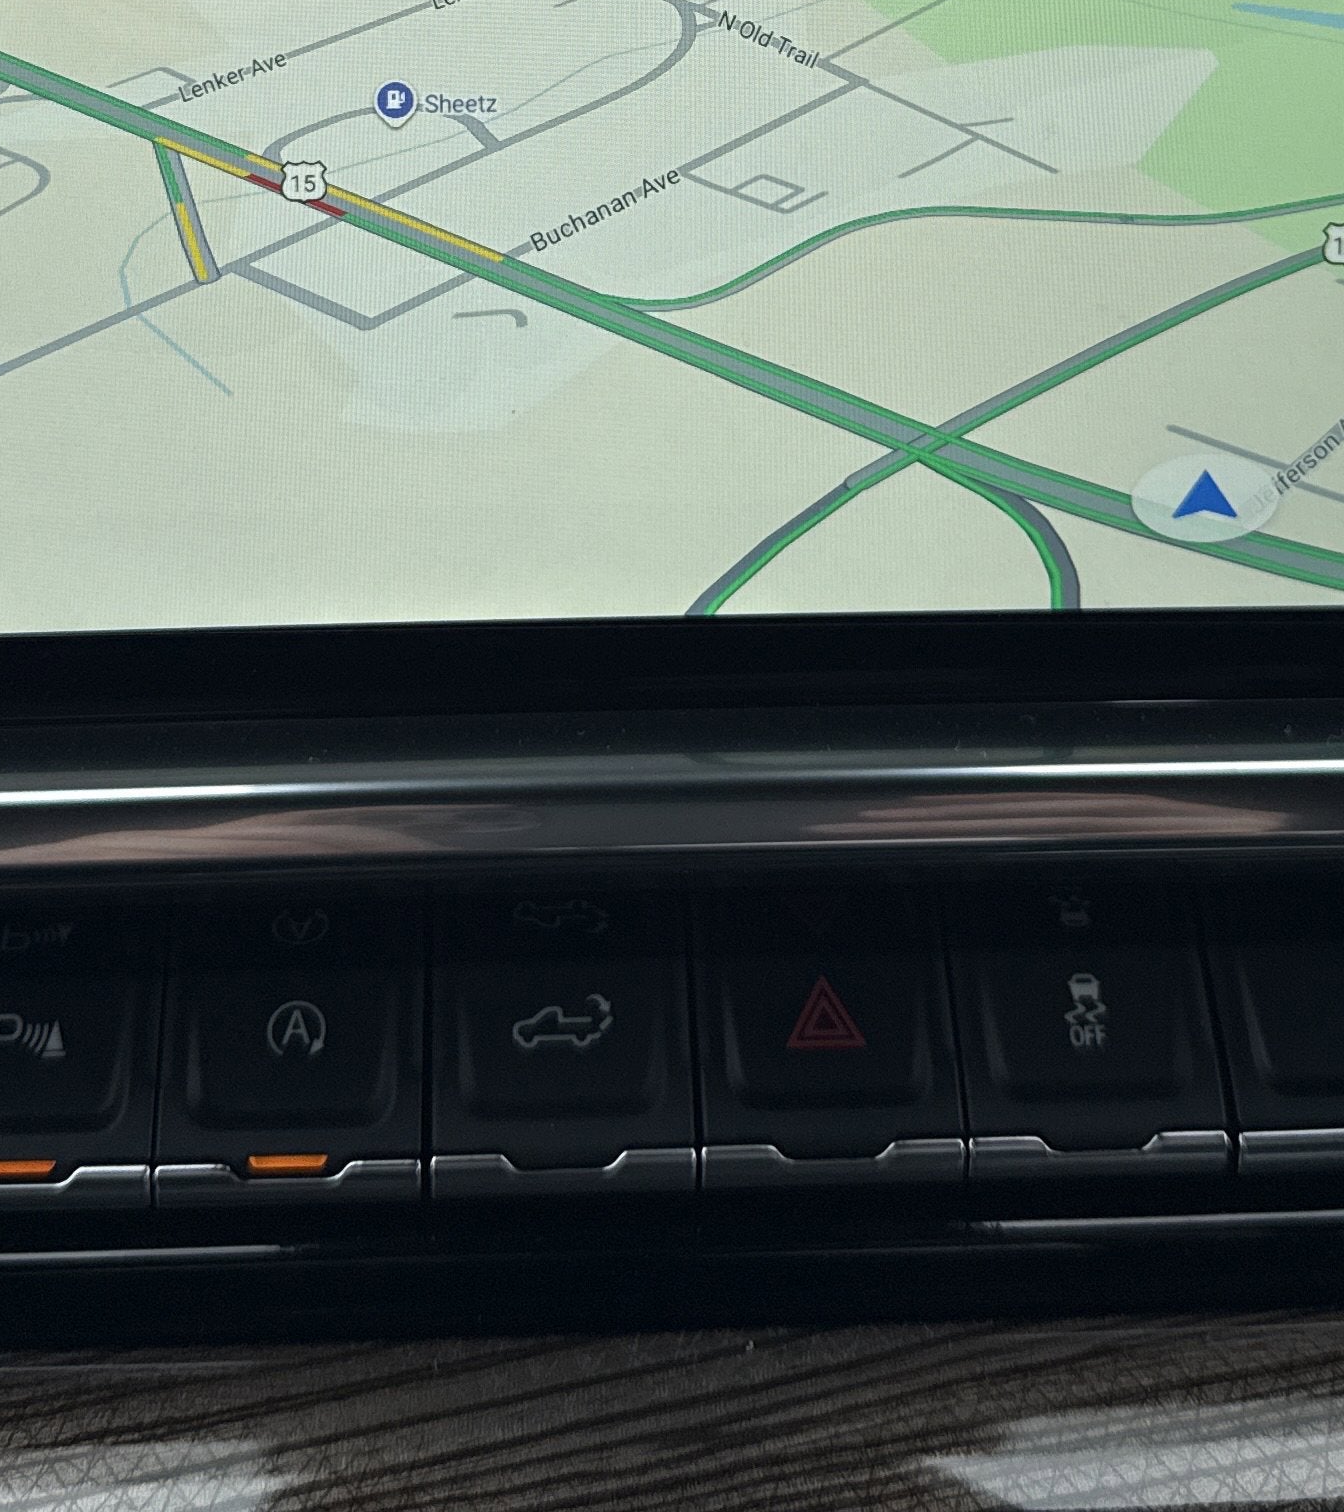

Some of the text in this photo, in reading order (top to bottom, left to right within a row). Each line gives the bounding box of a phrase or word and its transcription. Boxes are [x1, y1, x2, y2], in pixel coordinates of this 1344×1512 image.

[717, 9, 821, 69] N Old Trail
[178, 52, 288, 103] Lenker Ave
[424, 93, 498, 114] Sheetz
[290, 174, 317, 193] 15
[529, 168, 682, 252] Buchanan Ave
[282, 1009, 310, 1045] A
[1069, 1024, 1106, 1047] OFF
